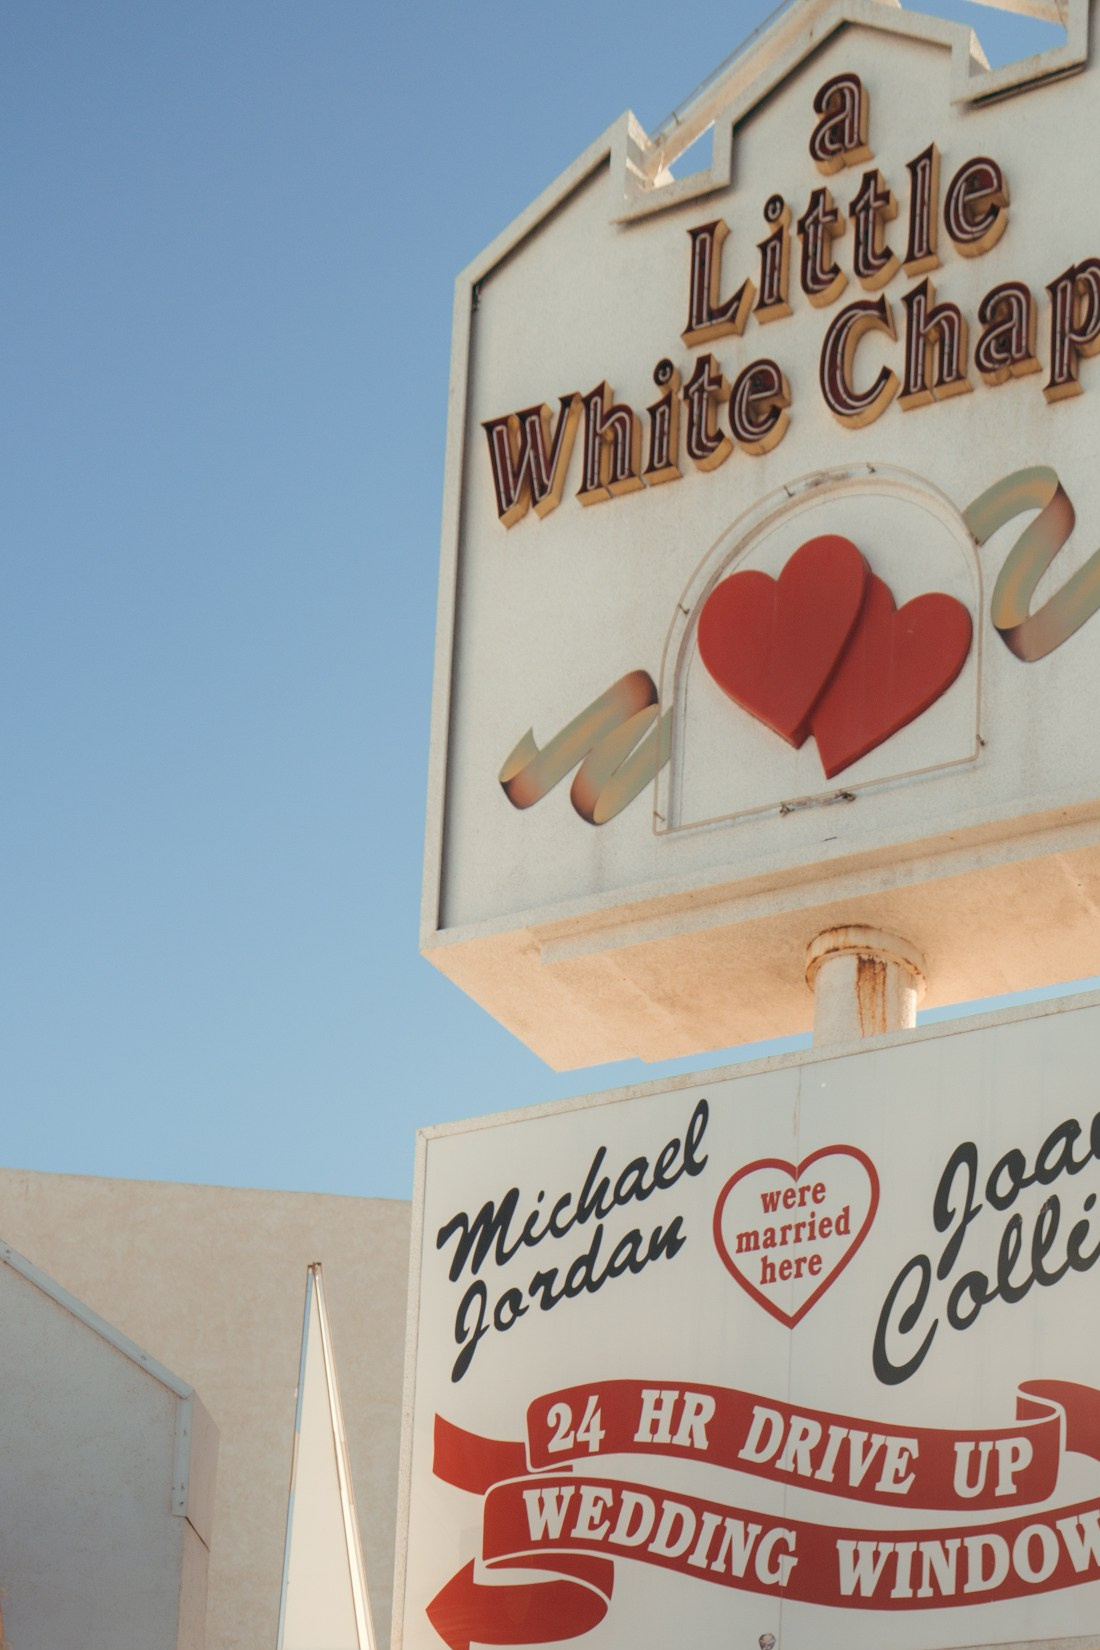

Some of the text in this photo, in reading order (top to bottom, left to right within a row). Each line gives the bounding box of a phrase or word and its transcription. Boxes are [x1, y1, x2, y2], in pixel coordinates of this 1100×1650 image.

[808, 72, 872, 175] a
[680, 141, 1010, 349] Little
[481, 355, 792, 530] White
[436, 1098, 710, 1284] Michael
[734, 1205, 851, 1255] married
[760, 1179, 828, 1215] were
[450, 1214, 687, 1384] Jordan
[759, 1248, 824, 1287] here
[546, 1388, 1034, 1499] 24 HR DRIVE UP
[522, 1483, 799, 1588] WEDDING
